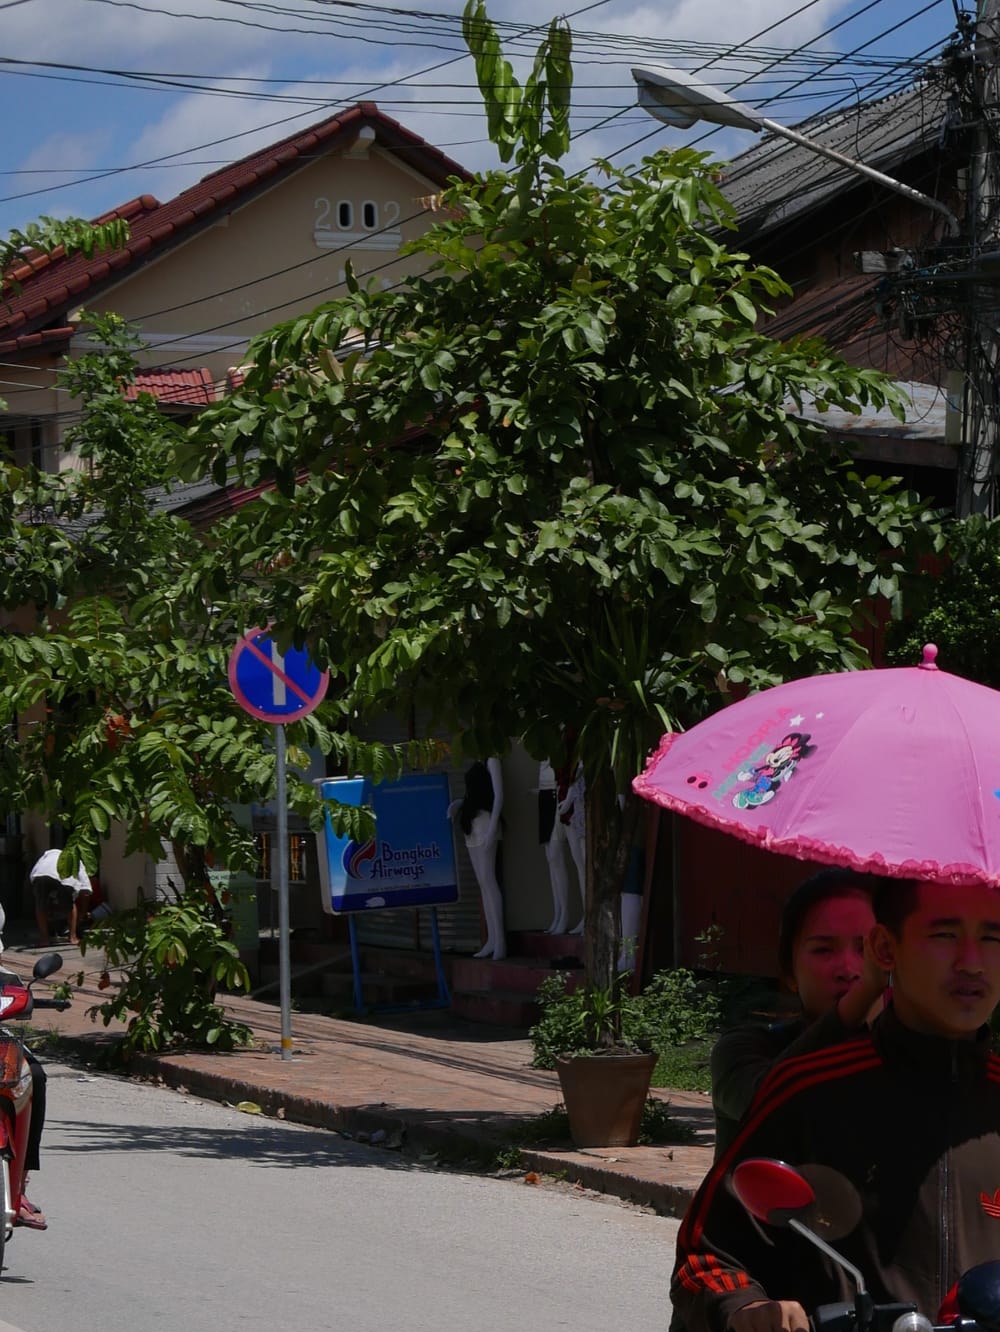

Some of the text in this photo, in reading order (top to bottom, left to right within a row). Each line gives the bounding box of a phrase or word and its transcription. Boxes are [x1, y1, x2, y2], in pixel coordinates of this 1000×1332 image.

[314, 197, 401, 232] 2002
[382, 842, 440, 864] Bangkok
[369, 859, 425, 879] Airways
